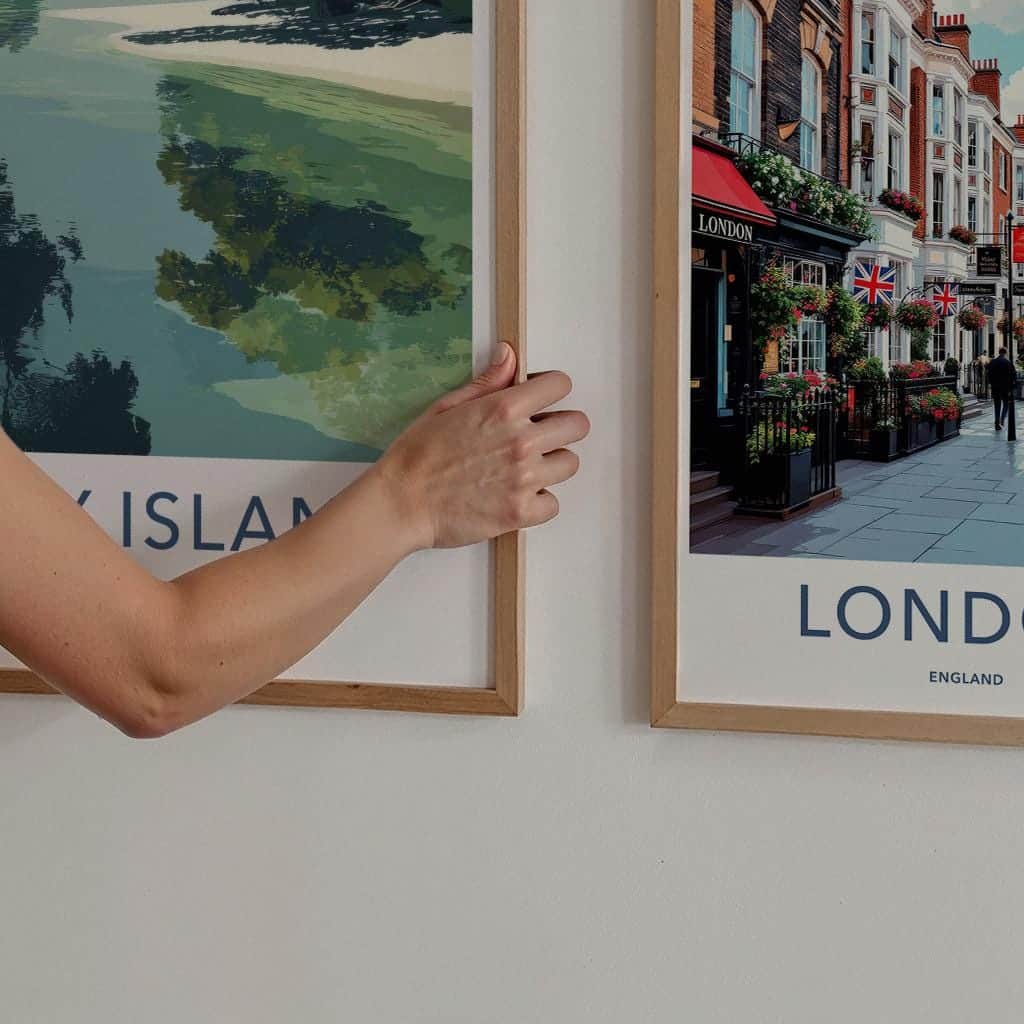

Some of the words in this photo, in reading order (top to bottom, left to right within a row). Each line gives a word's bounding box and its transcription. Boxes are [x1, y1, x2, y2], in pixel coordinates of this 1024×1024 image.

[699, 213, 753, 242] LONDON
[800, 584, 1024, 645] LOND
[929, 670, 1004, 686] ENGLAND
